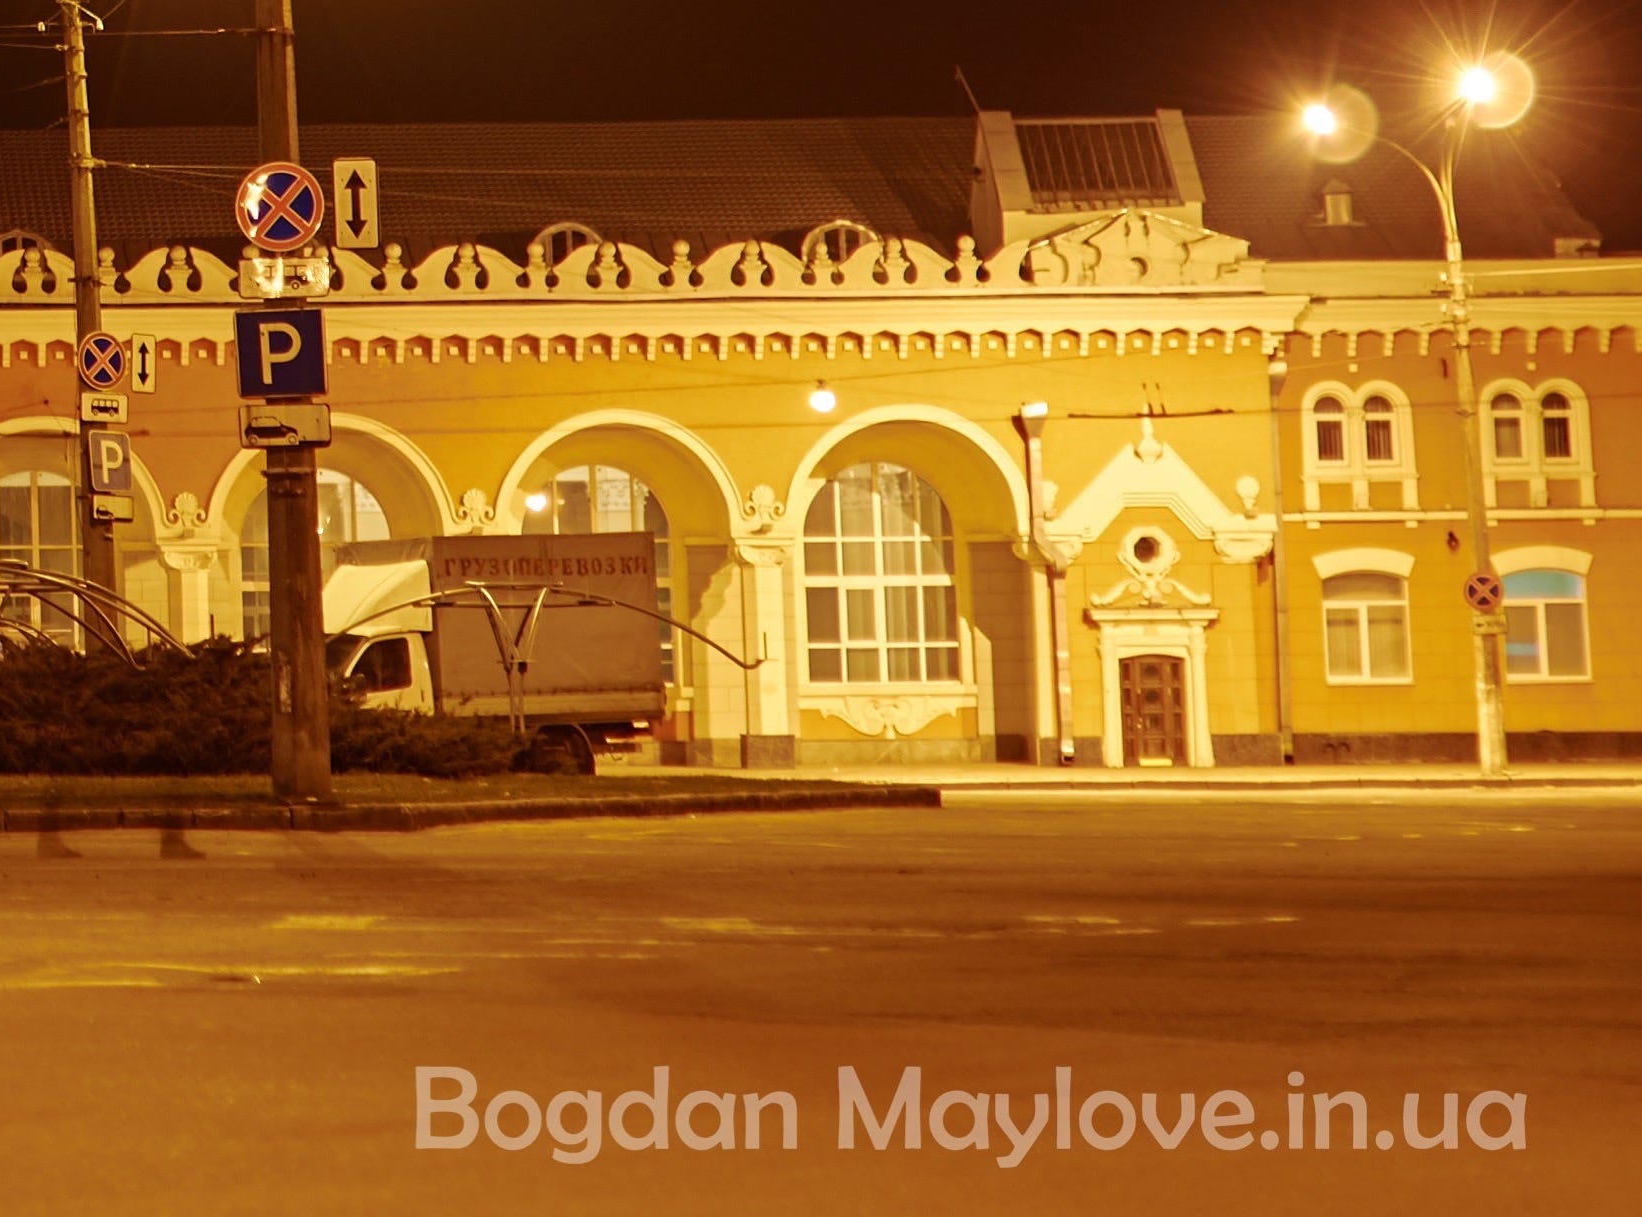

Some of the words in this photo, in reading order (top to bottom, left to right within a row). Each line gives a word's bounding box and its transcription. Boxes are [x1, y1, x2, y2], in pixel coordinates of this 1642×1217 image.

[259, 323, 301, 385] P
[100, 440, 123, 484] P
[444, 556, 648, 577] ГРУЗОПЕРЕВОЗКИ
